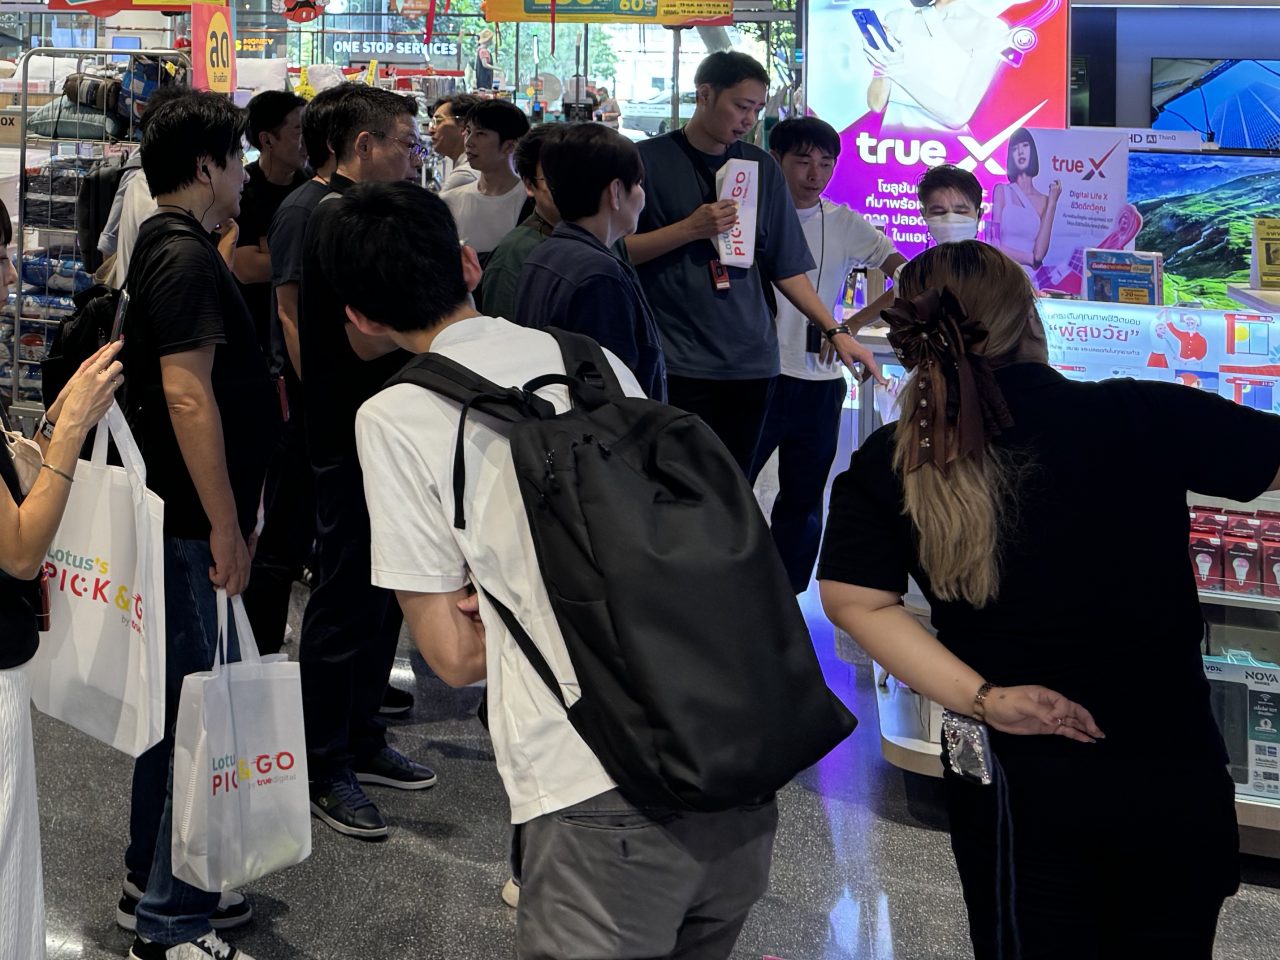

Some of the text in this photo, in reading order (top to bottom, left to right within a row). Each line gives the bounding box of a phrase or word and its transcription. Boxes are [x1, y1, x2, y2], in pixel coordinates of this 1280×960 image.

[210, 30, 229, 68] ลด
[333, 41, 458, 55] ONE STOP SERVICES
[856, 132, 947, 166] true
[1052, 155, 1084, 173] true
[731, 171, 746, 198] GO
[1070, 191, 1089, 200] Digital
[1090, 192, 1102, 201] Life
[47, 548, 109, 575] Lotus's
[45, 561, 130, 612] PICK &
[1245, 671, 1279, 683] NOVA
[212, 753, 236, 772] Lotu
[213, 770, 238, 796] PIC
[254, 751, 295, 774] GO
